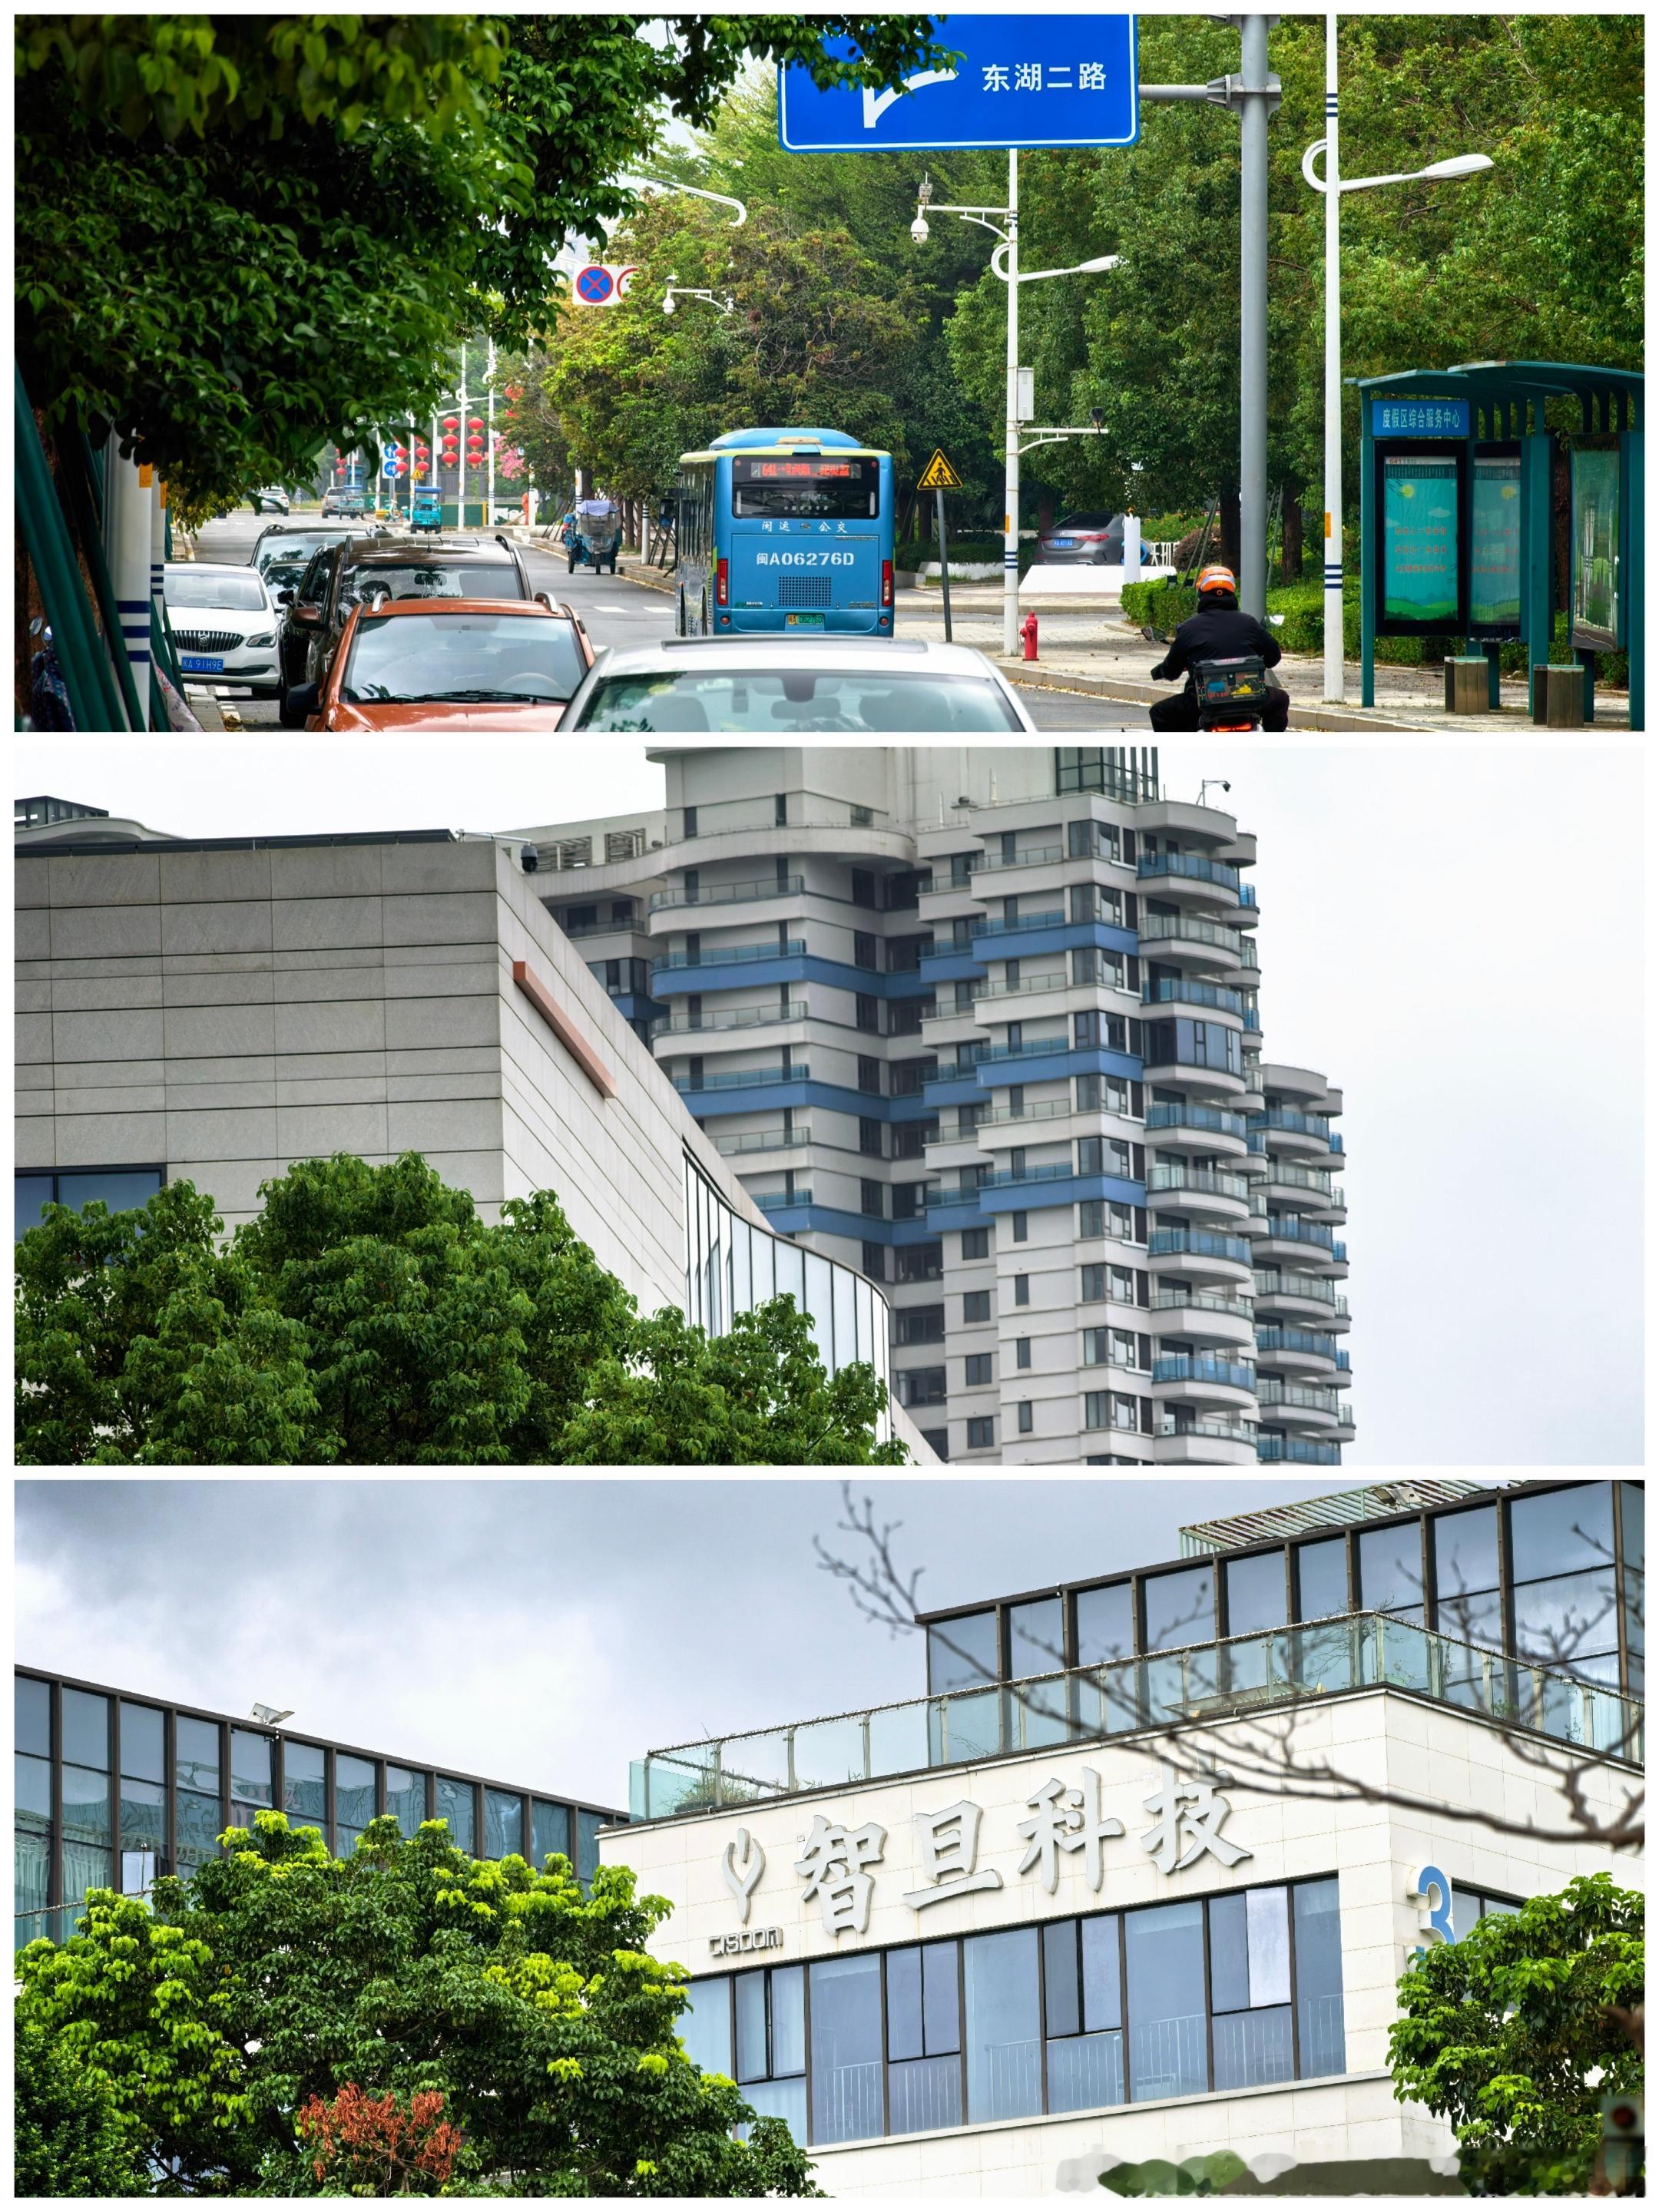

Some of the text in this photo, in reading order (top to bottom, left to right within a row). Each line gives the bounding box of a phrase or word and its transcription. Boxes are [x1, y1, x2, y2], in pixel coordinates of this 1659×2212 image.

[982, 61, 1107, 91] 东湖二路
[1382, 407, 1461, 429] 度假区综合服务中心
[762, 520, 849, 534] 闽运 公交
[757, 552, 855, 566] 闽A06276D
[793, 1750, 1253, 1936] 智旦科技
